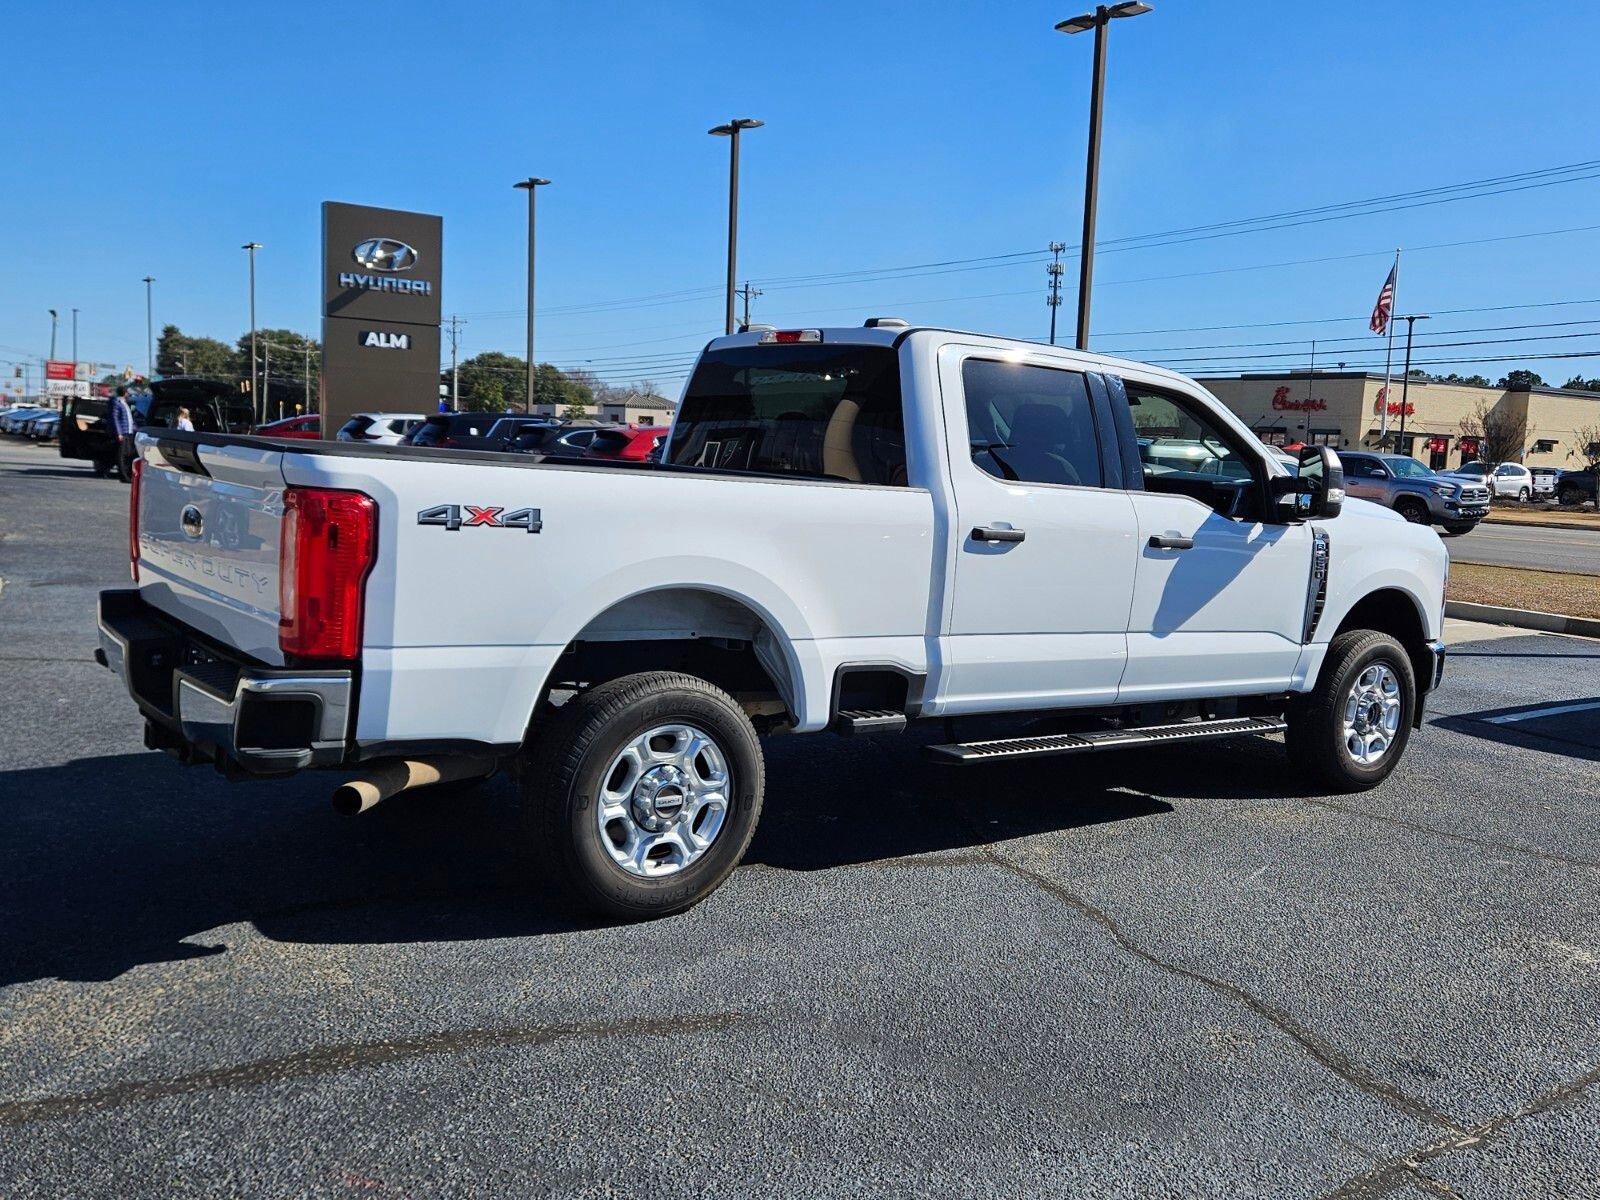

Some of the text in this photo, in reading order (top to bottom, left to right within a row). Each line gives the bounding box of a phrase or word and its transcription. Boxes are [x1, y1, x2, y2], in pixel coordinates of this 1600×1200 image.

[340, 272, 432, 296] HYUNDAI
[365, 332, 408, 349] ALM
[201, 559, 269, 594] DUTY
